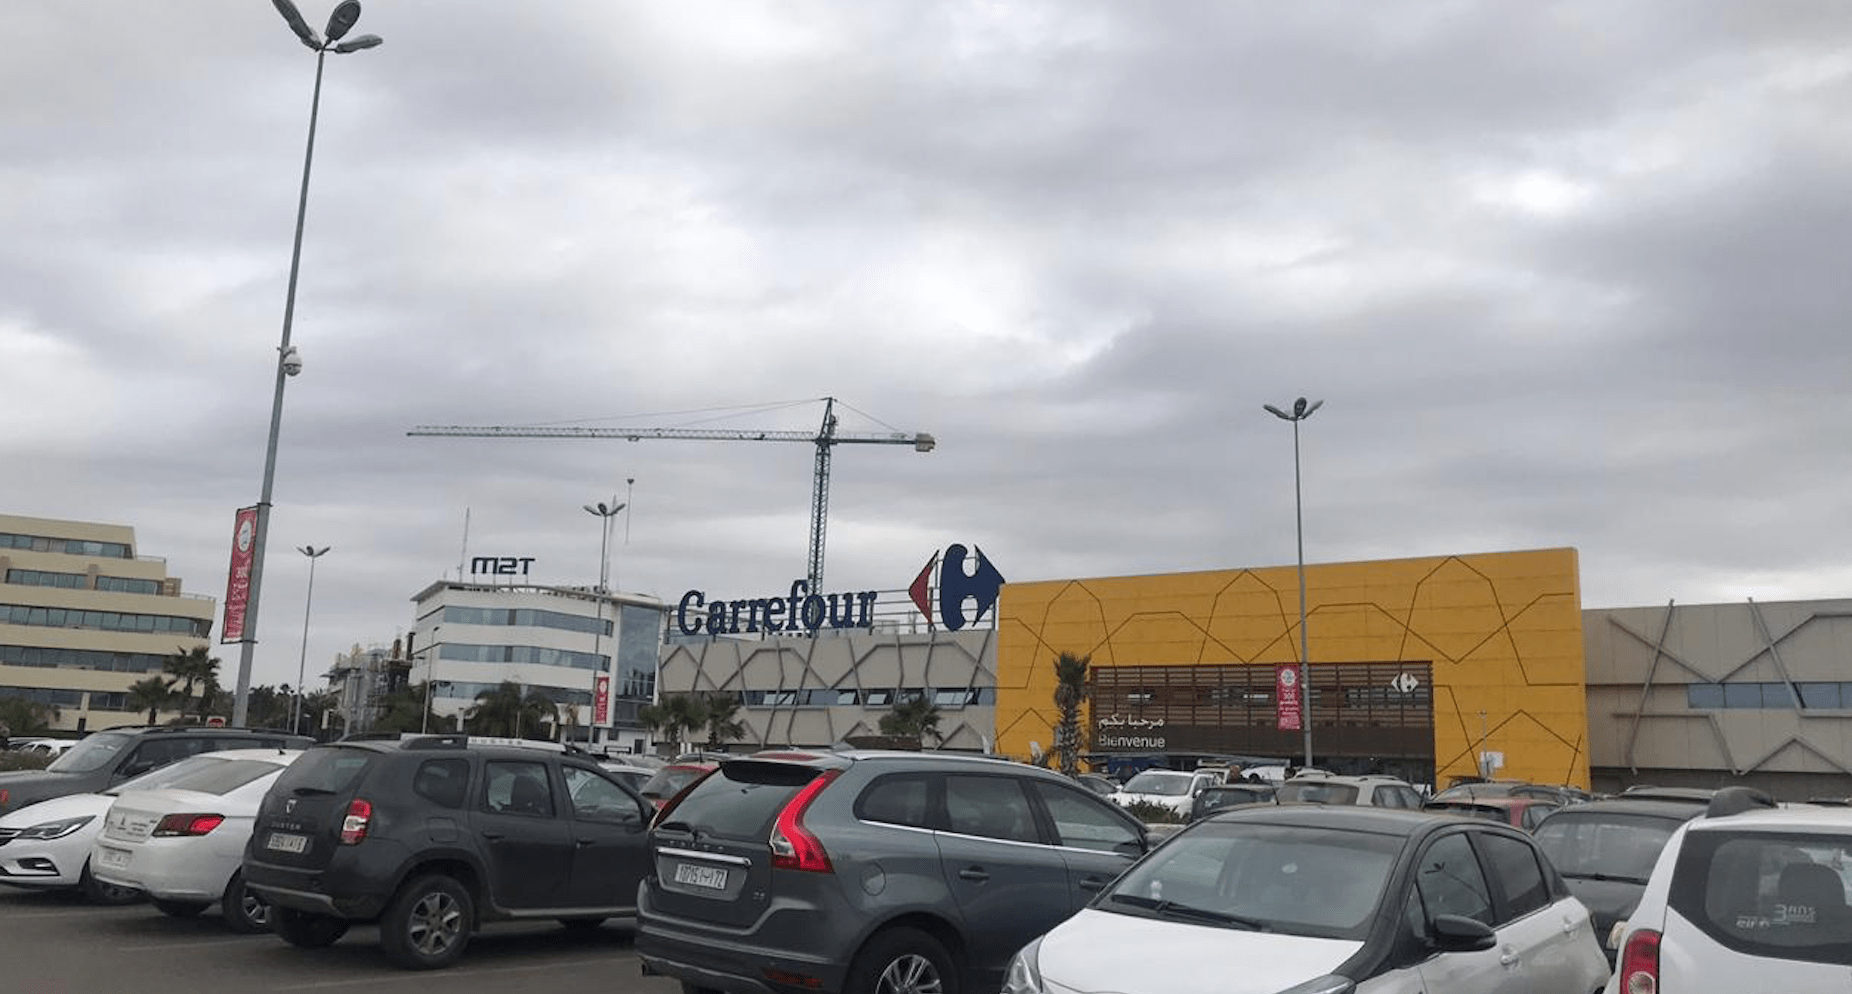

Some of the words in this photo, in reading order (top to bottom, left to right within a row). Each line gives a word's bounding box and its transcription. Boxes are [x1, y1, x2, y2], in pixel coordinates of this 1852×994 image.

[472, 557, 536, 574] M2T
[678, 580, 877, 636] Carrefour
[1098, 713, 1125, 729] بكم
[1128, 714, 1164, 729] مرحبا
[1099, 734, 1166, 748] Bienvenue
